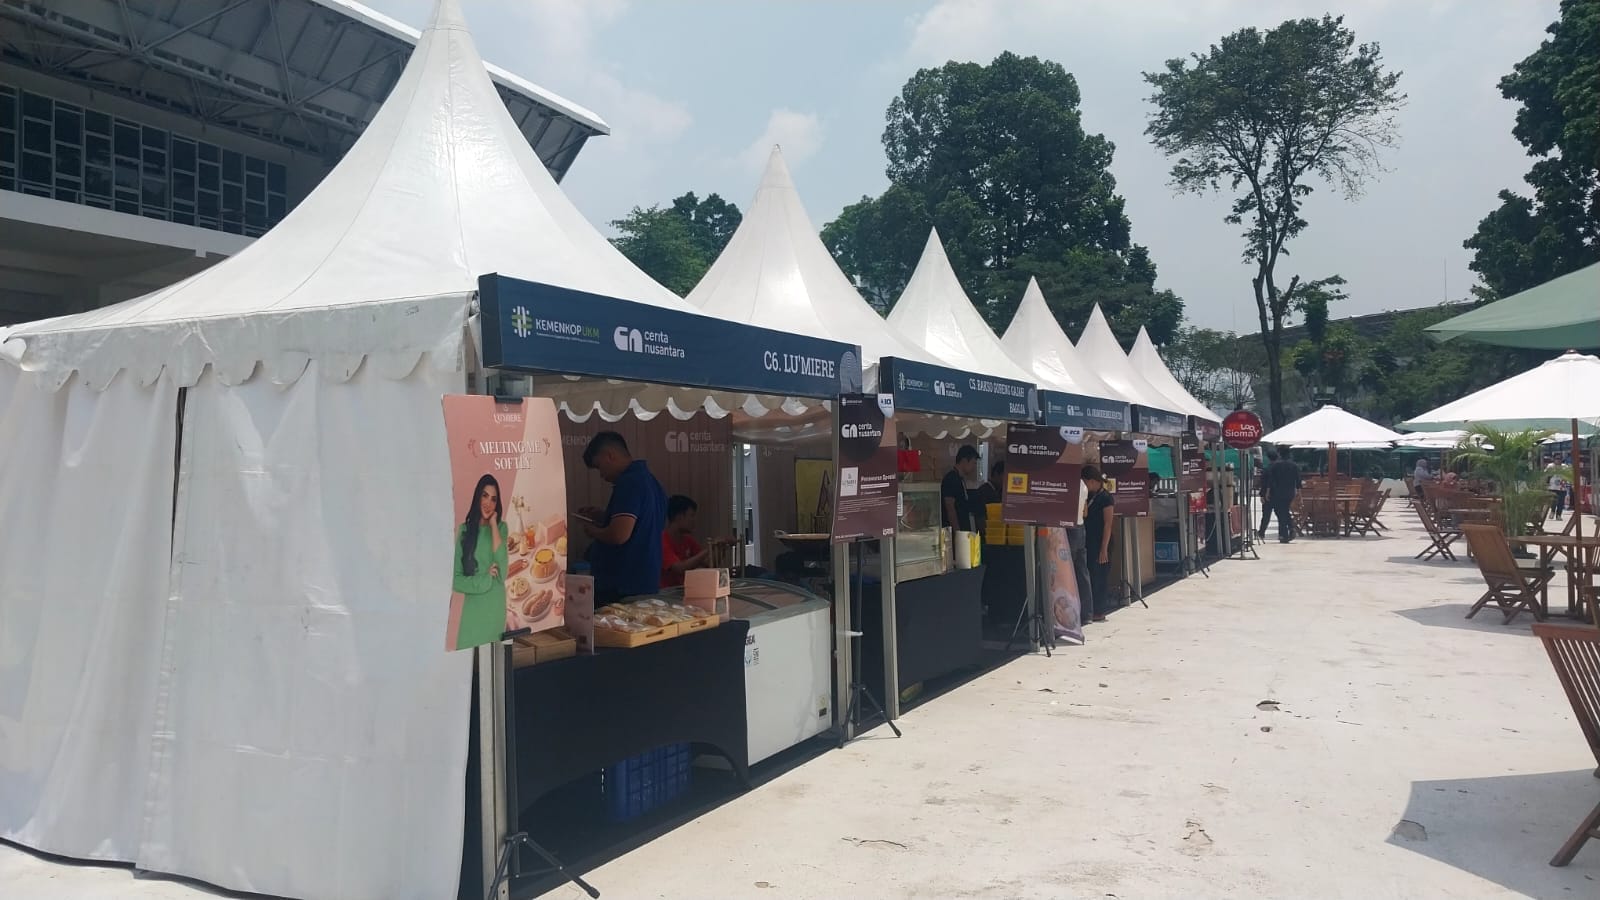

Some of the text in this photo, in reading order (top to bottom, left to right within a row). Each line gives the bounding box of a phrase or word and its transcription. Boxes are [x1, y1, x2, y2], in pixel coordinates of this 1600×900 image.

[644, 331, 669, 343] cerita
[644, 344, 685, 358] nusantara
[764, 350, 835, 379] C6. LU'MIERE
[480, 440, 542, 454] MELTING ME
[494, 456, 532, 470] SOFTLY
